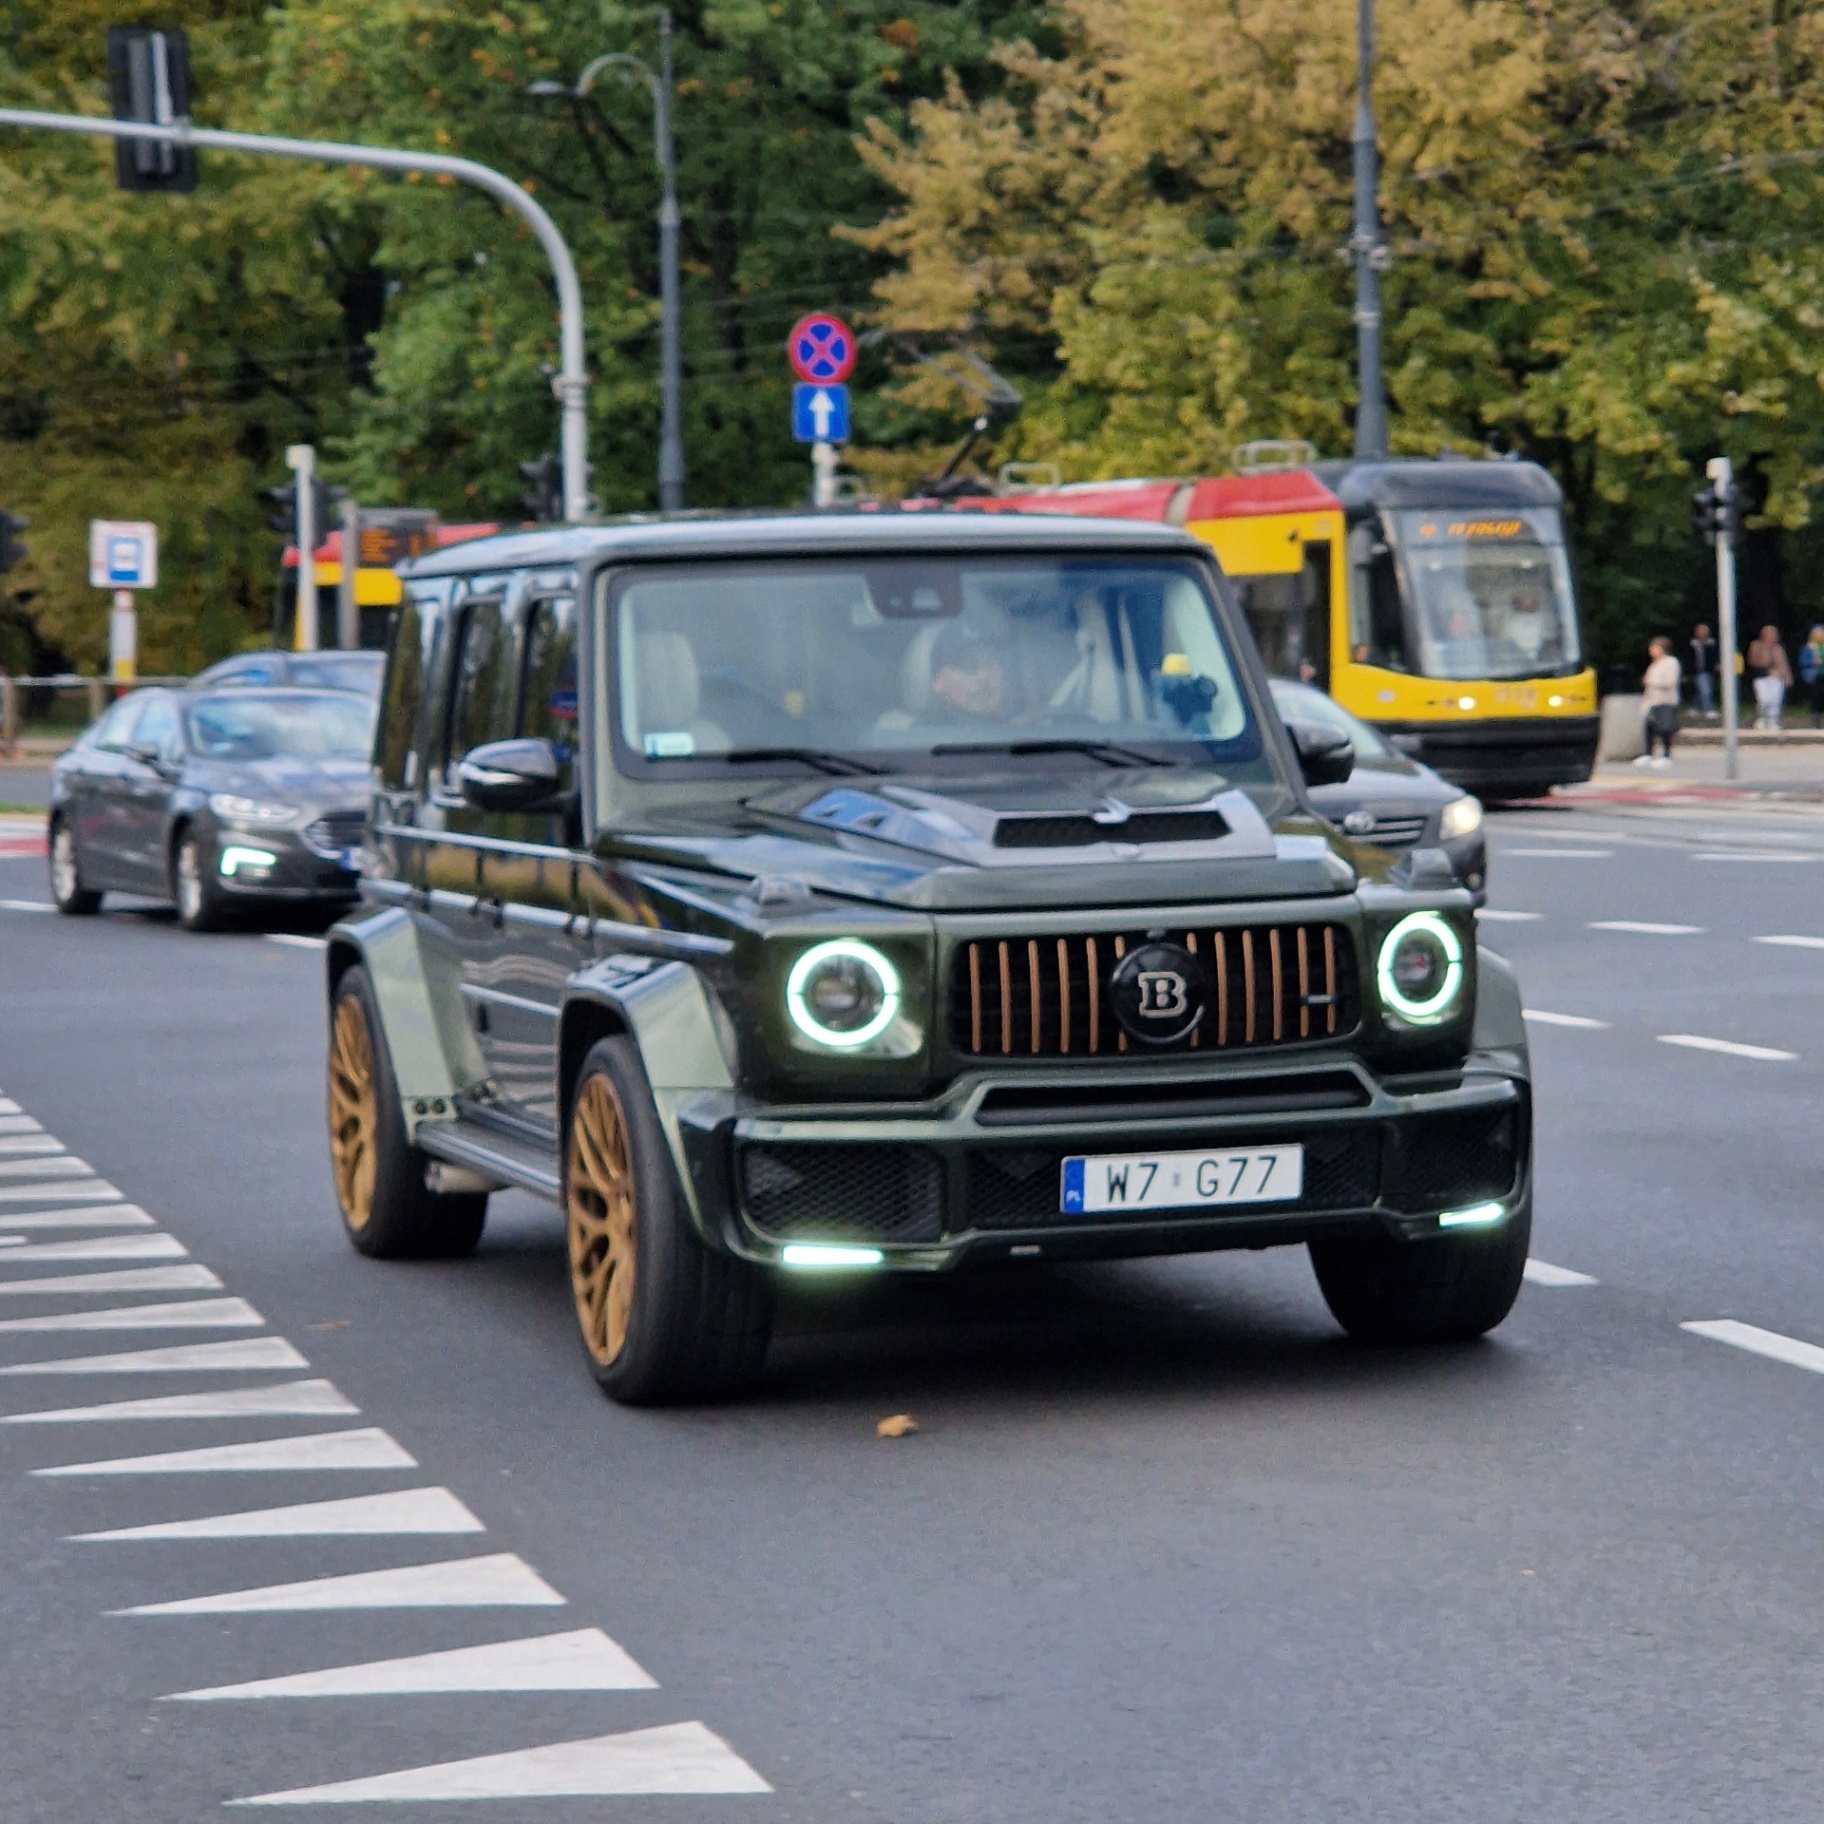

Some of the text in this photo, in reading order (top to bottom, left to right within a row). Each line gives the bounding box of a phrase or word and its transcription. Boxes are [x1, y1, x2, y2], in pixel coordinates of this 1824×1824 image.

[1138, 971, 1187, 1018] B
[1107, 1155, 1278, 1203] W7 G77
